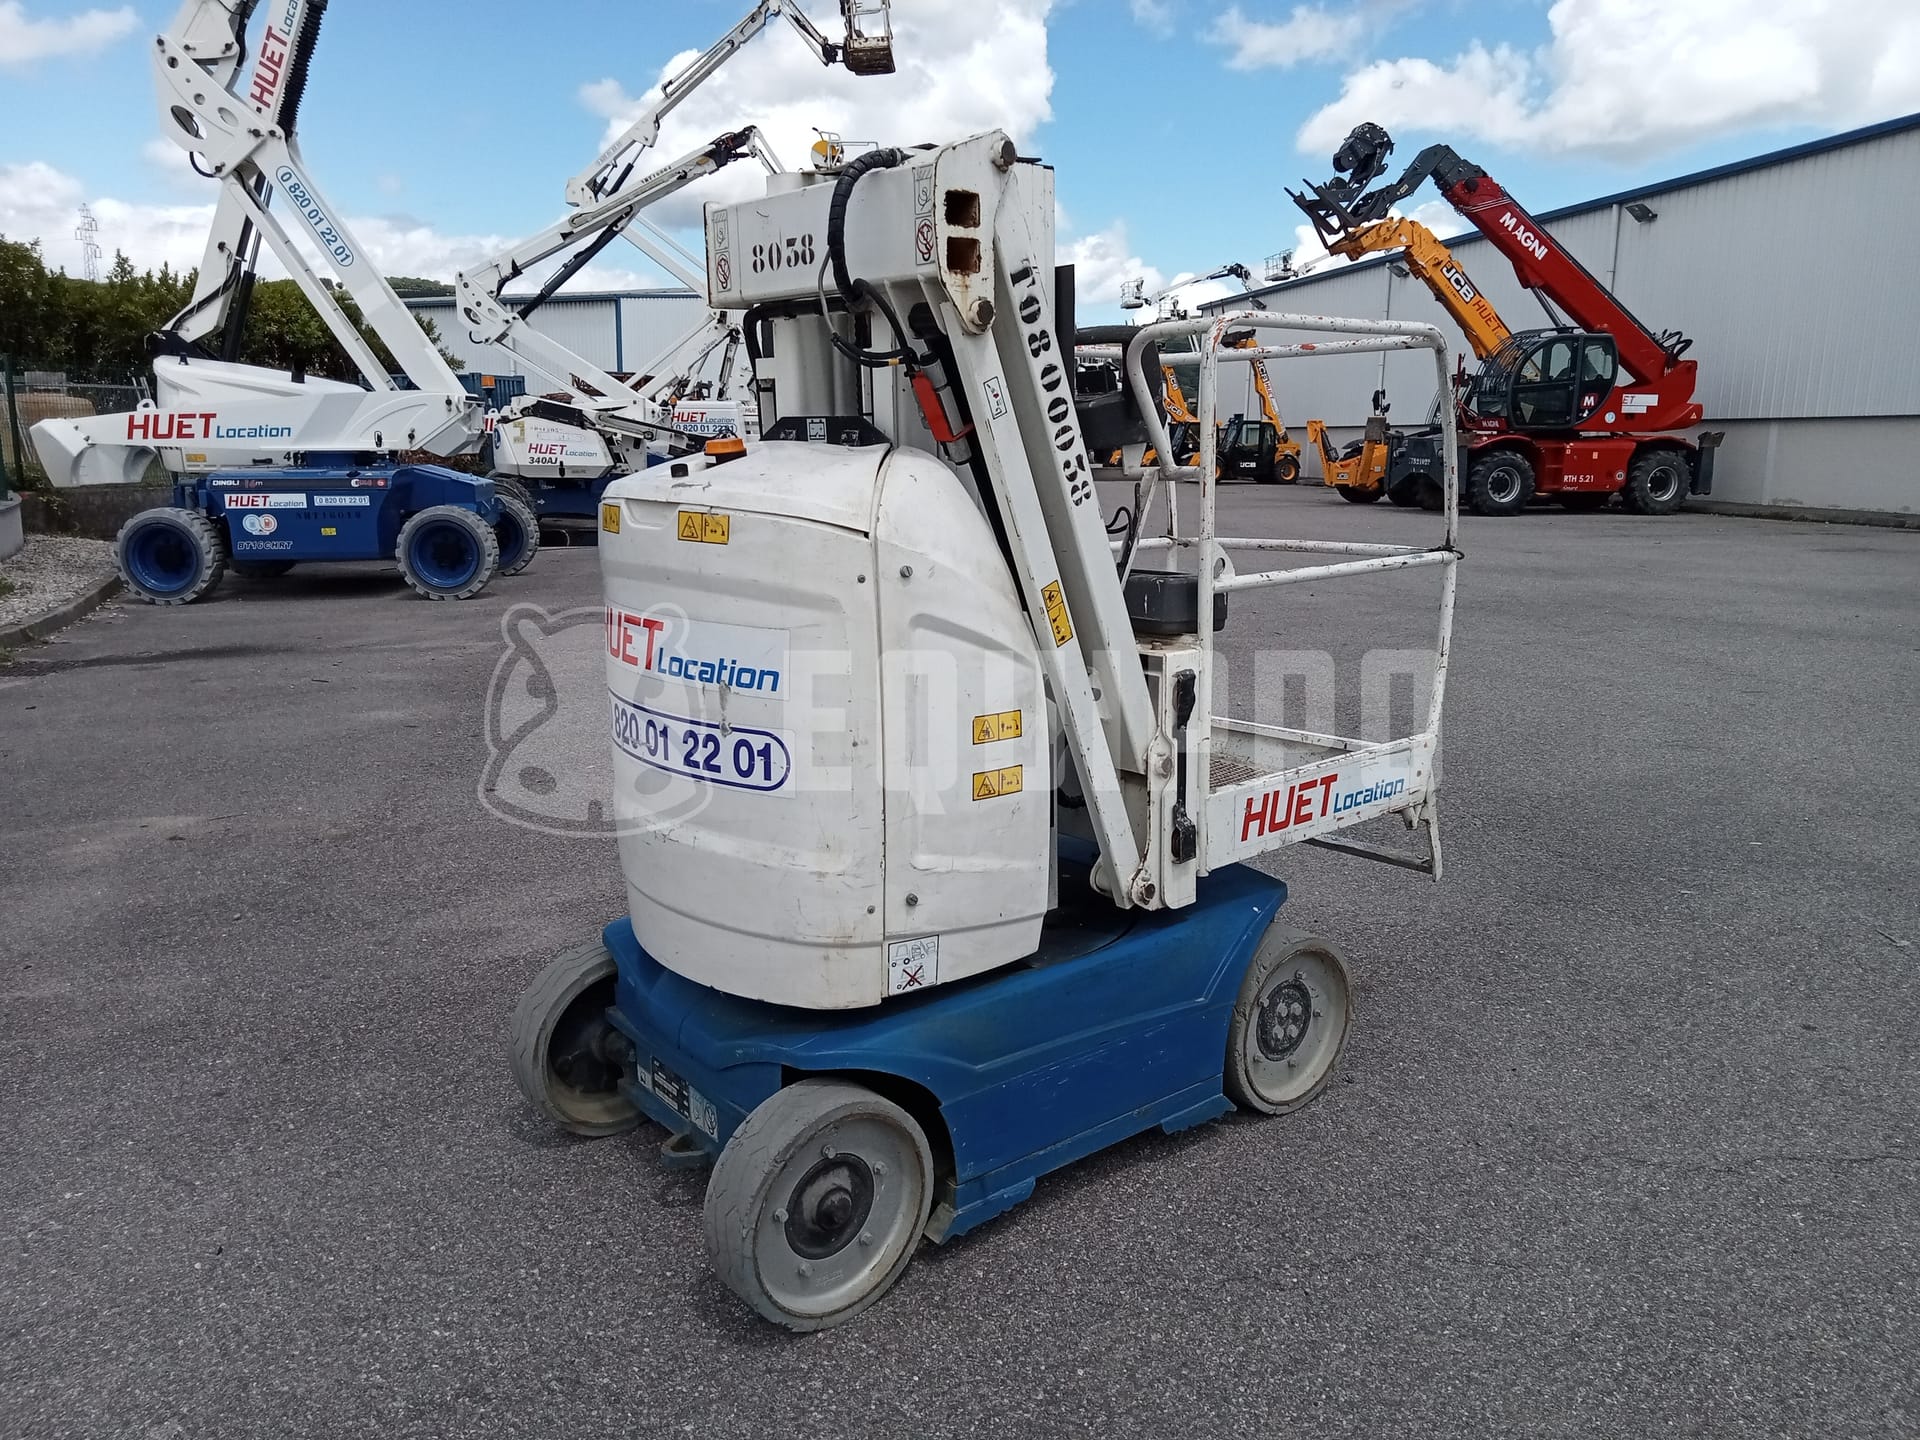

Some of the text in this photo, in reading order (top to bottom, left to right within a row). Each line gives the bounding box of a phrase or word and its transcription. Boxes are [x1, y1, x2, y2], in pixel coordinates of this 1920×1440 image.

[250, 0, 299, 108] HUET Loca
[281, 172, 351, 262] 0 820 01 22 01
[1499, 211, 1548, 260] MAGNI
[1442, 265, 1475, 302] JCB
[1473, 300, 1502, 331] HUET
[127, 413, 291, 439] HUET Location
[672, 412, 706, 422] HUET
[682, 424, 698, 432] 820
[701, 424, 710, 432] 01
[528, 443, 567, 455] HUET
[528, 456, 558, 464] 340AJ
[1563, 474, 1578, 482] RTH
[228, 495, 304, 508] HUET Location
[606, 605, 780, 692] UET Location
[614, 703, 639, 750] 820
[645, 719, 669, 761] 01
[683, 729, 721, 774] 22
[733, 738, 772, 781] 01
[1241, 773, 1404, 842] HUET Location
